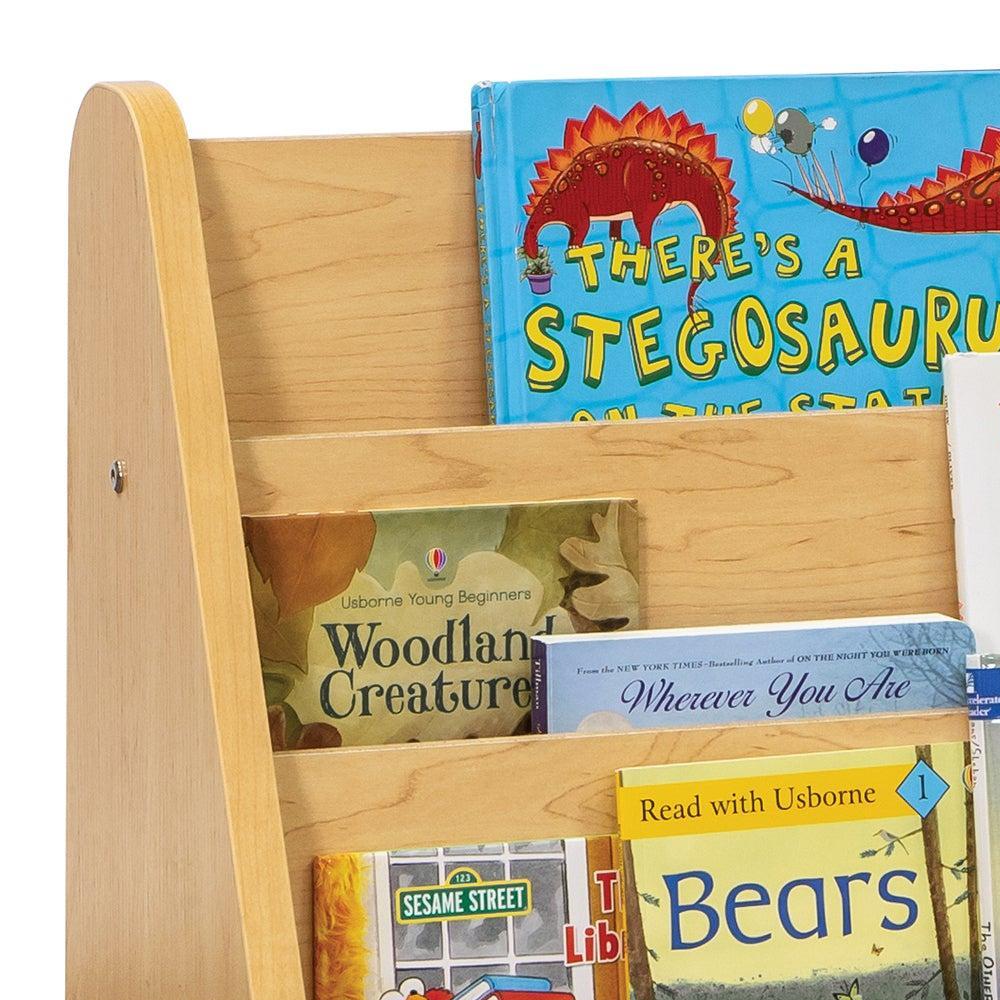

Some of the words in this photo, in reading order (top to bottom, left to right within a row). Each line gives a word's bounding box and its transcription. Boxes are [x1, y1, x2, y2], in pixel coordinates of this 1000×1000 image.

[565, 233, 802, 293] THERE'S
[824, 237, 863, 279] A
[341, 593, 403, 609] Usborne
[408, 592, 453, 608] Young
[458, 589, 531, 605] Beginners
[577, 666, 599, 675] From
[601, 665, 615, 674] the
[617, 664, 640, 673] NEW
[643, 662, 669, 672] YORK
[756, 655, 784, 666] Author
[786, 654, 795, 664] of
[797, 654, 811, 663] ON
[813, 653, 834, 662] THE
[836, 651, 868, 661] NIGHT
[869, 650, 891, 659] YOU
[893, 648, 920, 657] WERE
[921, 647, 950, 656] BORN
[620, 677, 756, 714] Wherever
[766, 670, 837, 718] You
[844, 666, 911, 702] Are
[640, 795, 703, 822] Read
[710, 789, 765, 816] with
[773, 785, 876, 812] Usborne
[917, 774, 929, 801] 1
[454, 873, 471, 884] 123
[403, 890, 464, 918] SESAME
[469, 886, 525, 912] STREET
[662, 869, 919, 951] Bears
[565, 921, 625, 965] Lib
[980, 921, 992, 952] The
